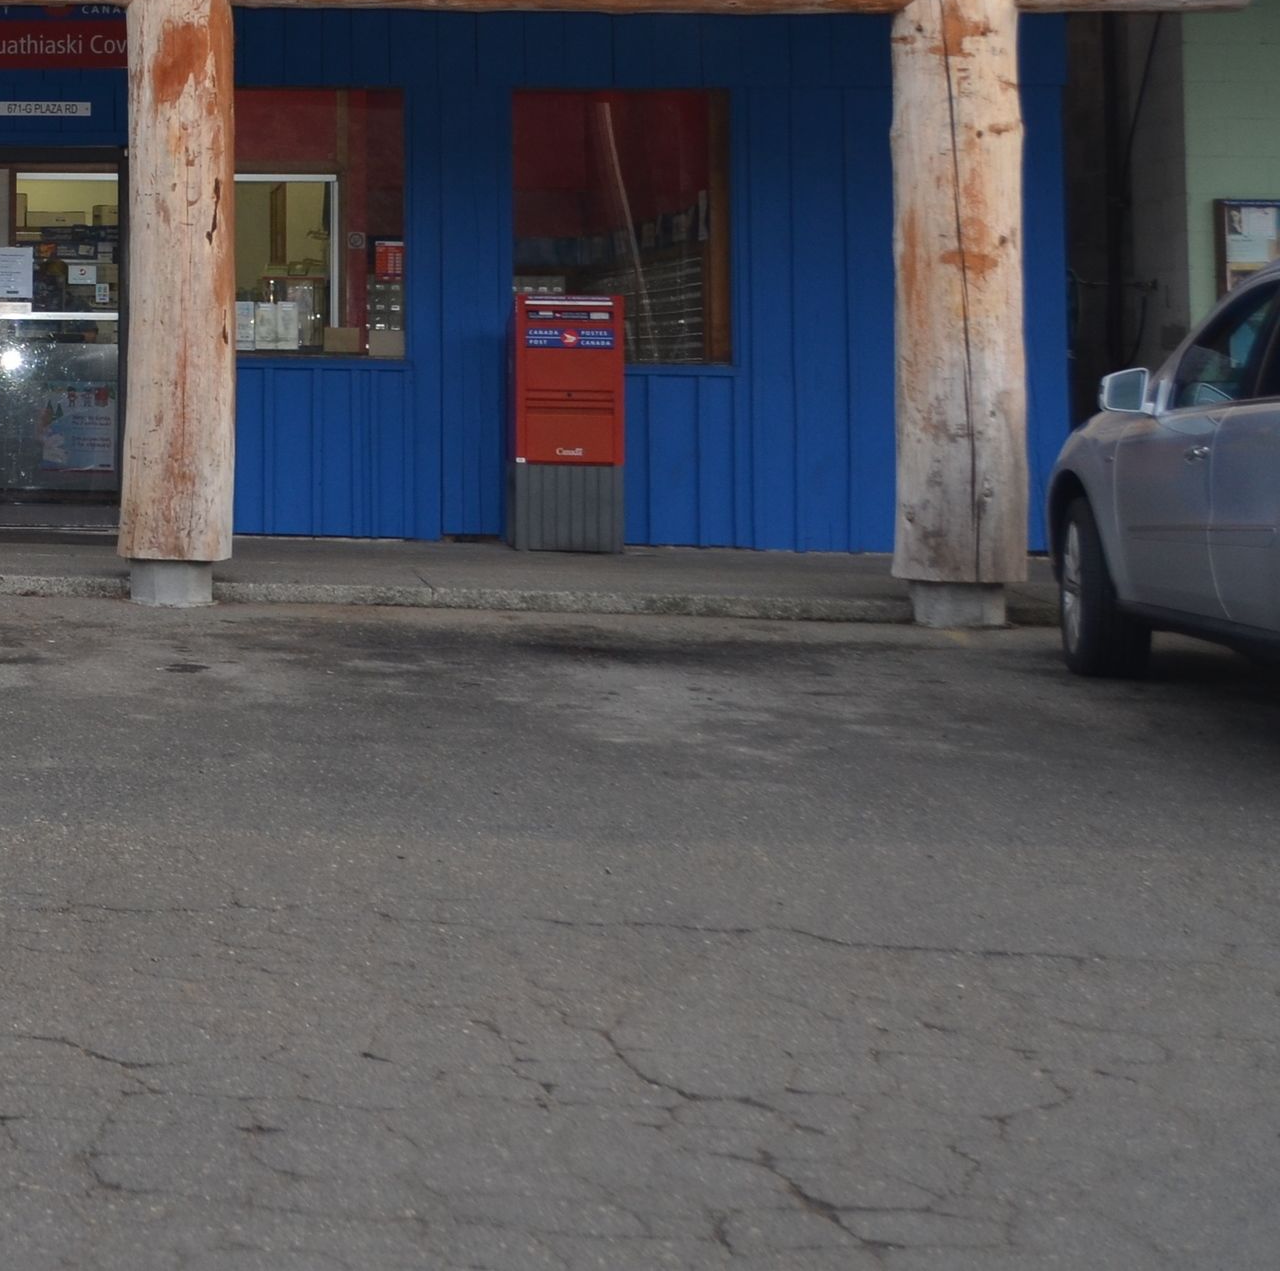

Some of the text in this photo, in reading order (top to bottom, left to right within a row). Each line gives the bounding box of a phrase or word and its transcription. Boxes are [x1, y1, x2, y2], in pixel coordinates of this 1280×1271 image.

[81, 6, 127, 15] CANA
[90, 34, 128, 55] Cov
[7, 104, 78, 114] 671-G PLAZA RD
